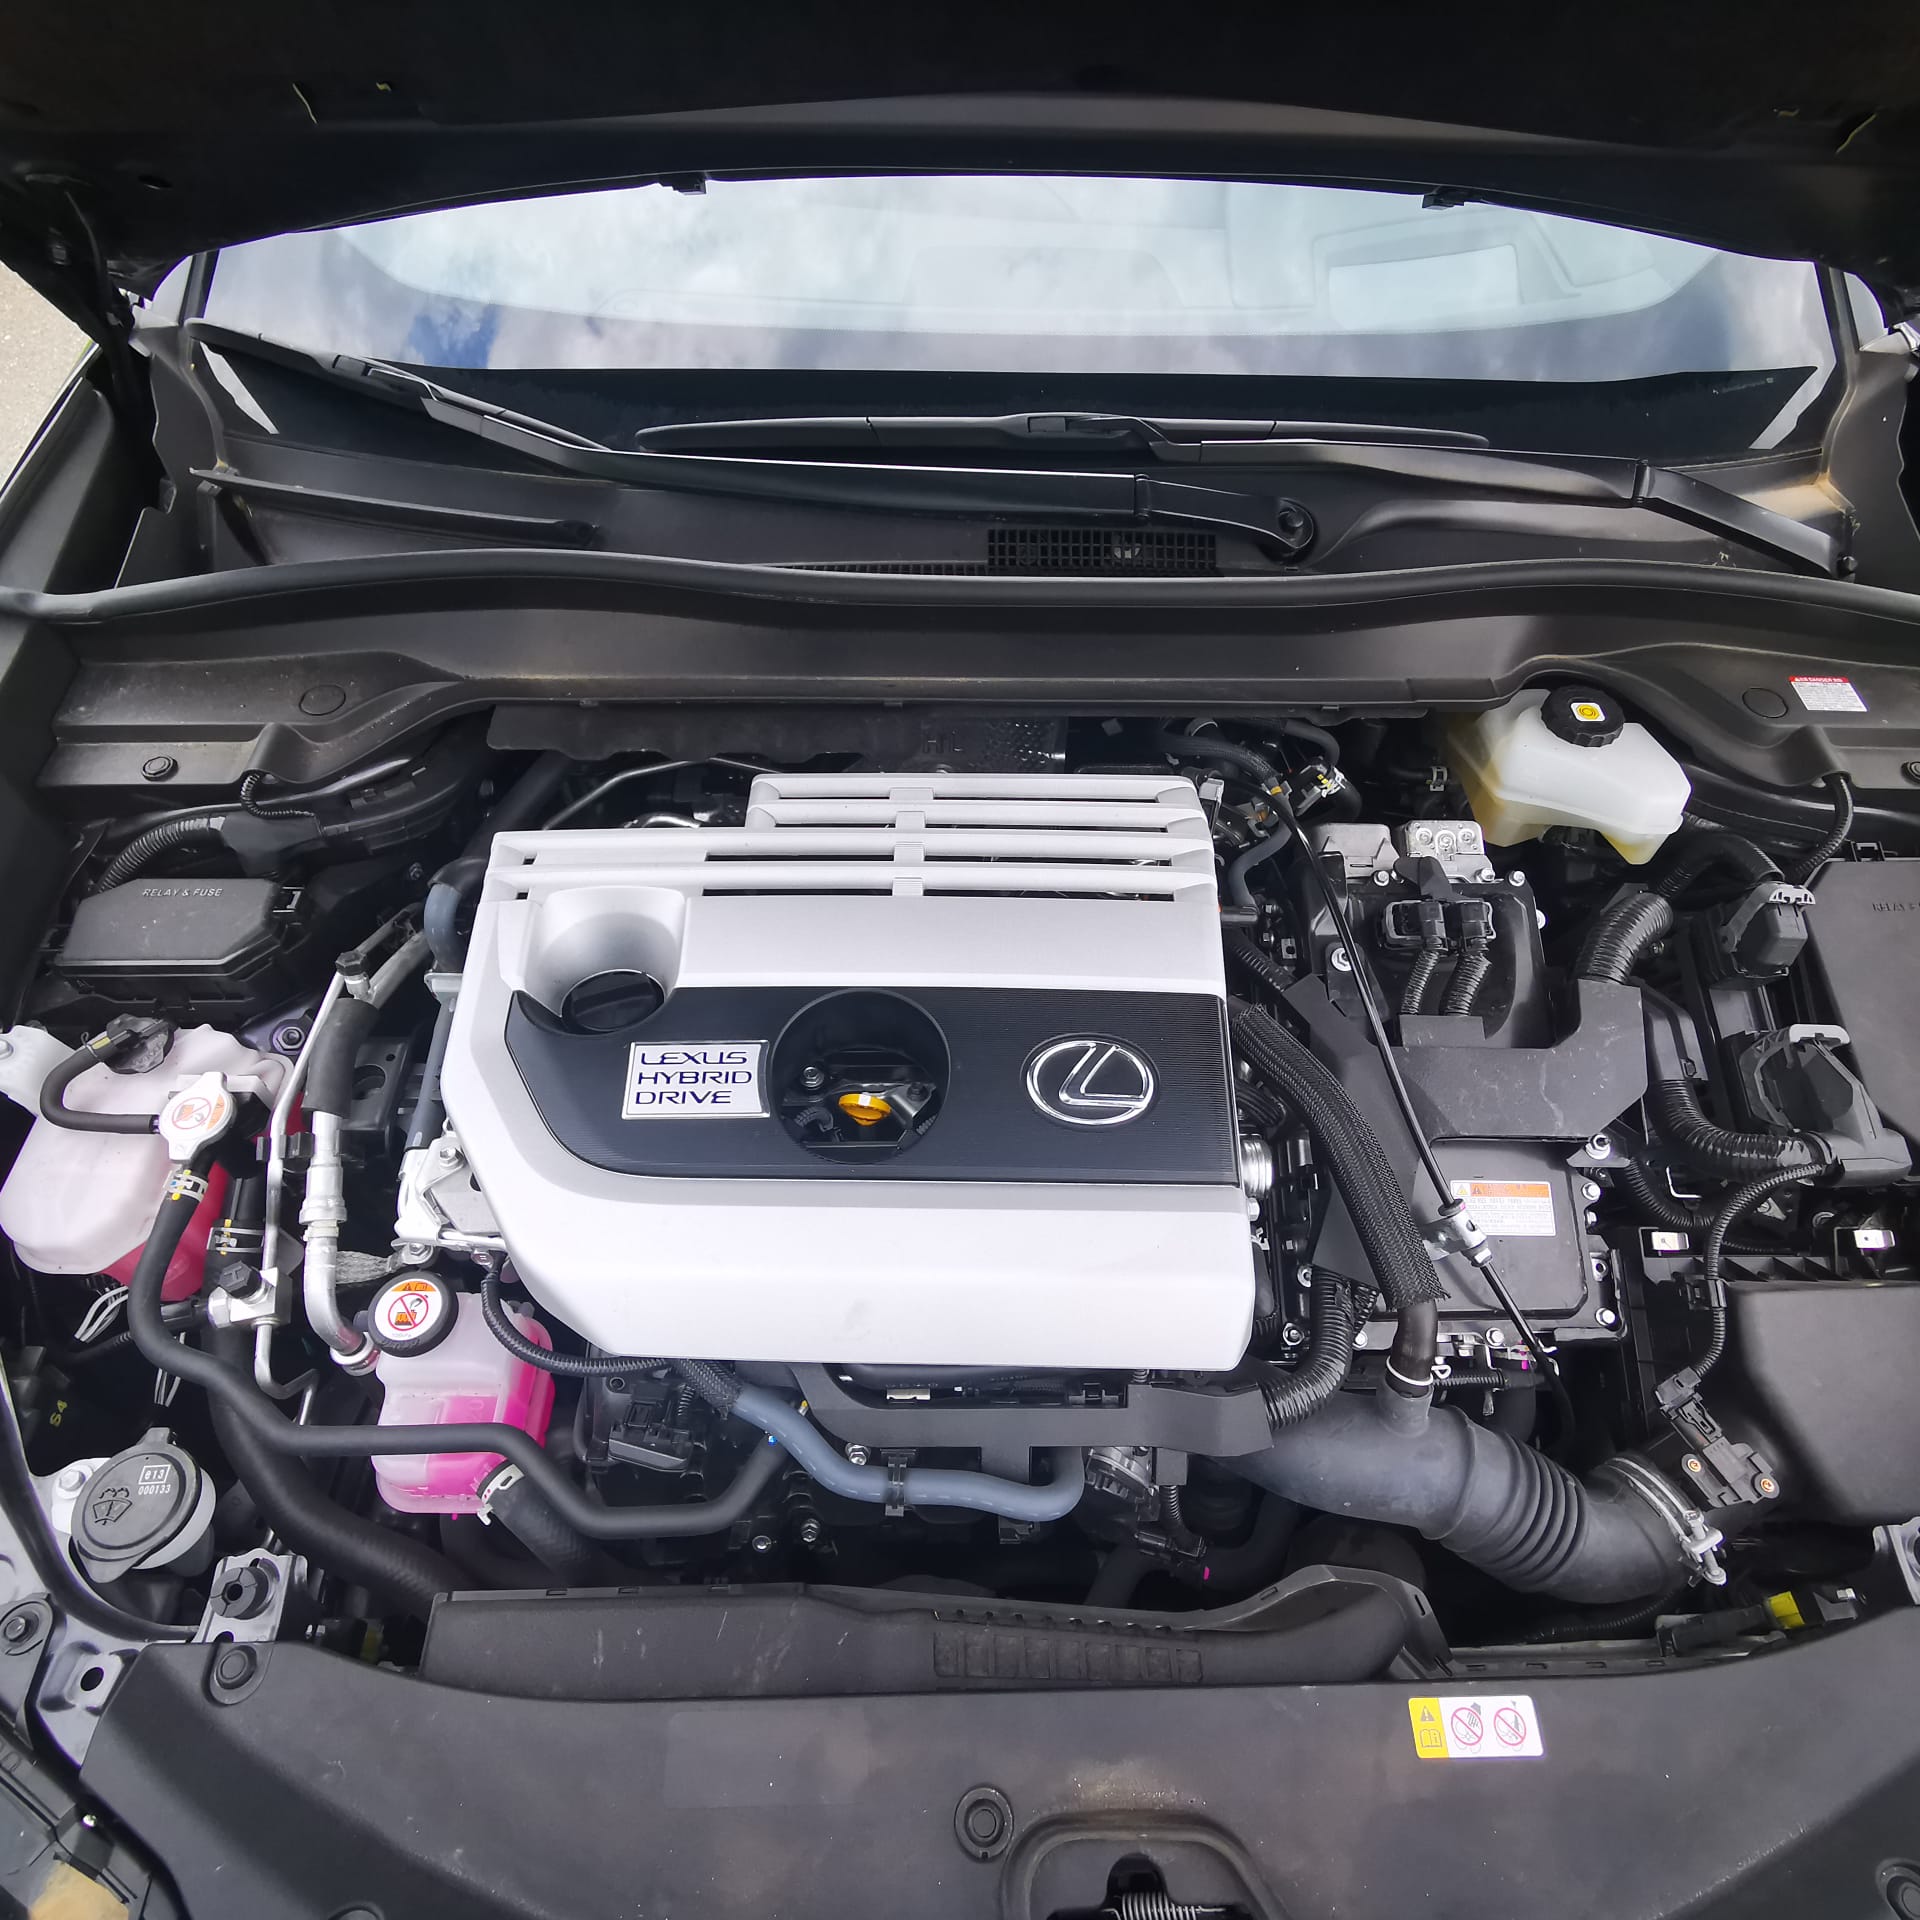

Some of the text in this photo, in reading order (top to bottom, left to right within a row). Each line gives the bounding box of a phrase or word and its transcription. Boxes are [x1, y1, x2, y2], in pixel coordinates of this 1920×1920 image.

[142, 888, 223, 897] RELAY & FUSE
[641, 1051, 748, 1065] LEXUS
[638, 1071, 752, 1084] HYBRID
[635, 1090, 732, 1105] DRIVE
[144, 1469, 165, 1480] e13
[138, 1484, 171, 1495] 000133
